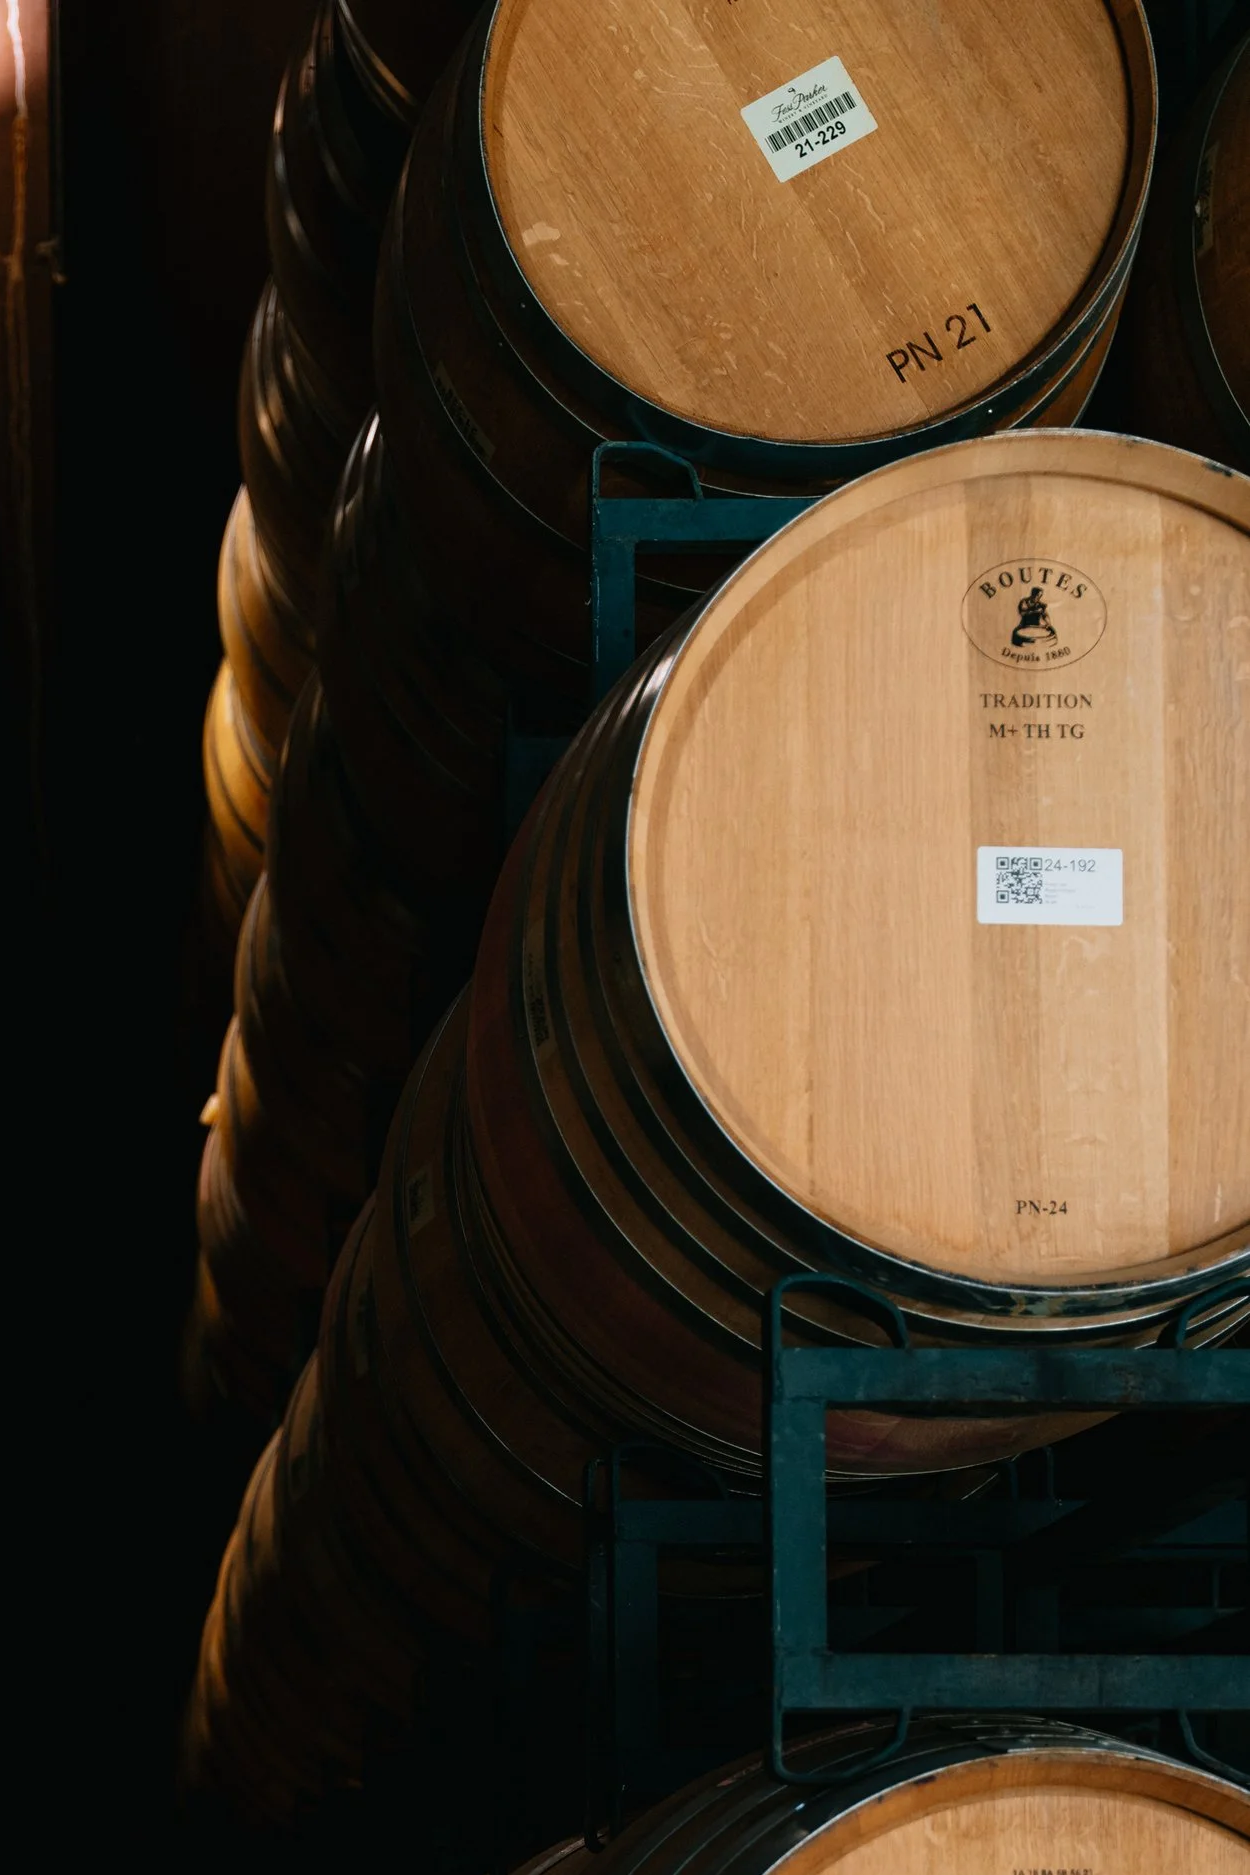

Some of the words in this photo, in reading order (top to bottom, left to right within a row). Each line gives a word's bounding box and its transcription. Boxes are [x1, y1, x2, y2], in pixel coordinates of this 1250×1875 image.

[792, 84, 828, 111] Parker
[795, 121, 847, 158] 21-229
[886, 331, 943, 384] PN
[945, 303, 991, 350] 21
[979, 566, 1088, 600] BOUTES
[1001, 647, 1040, 663] Depuis
[980, 693, 1093, 709] TRADITION
[989, 723, 1019, 738] M+
[1023, 723, 1051, 738] TH
[1057, 723, 1085, 739] TG
[1044, 859, 1096, 873] 24-192
[1014, 1199, 1068, 1215] PN-24
